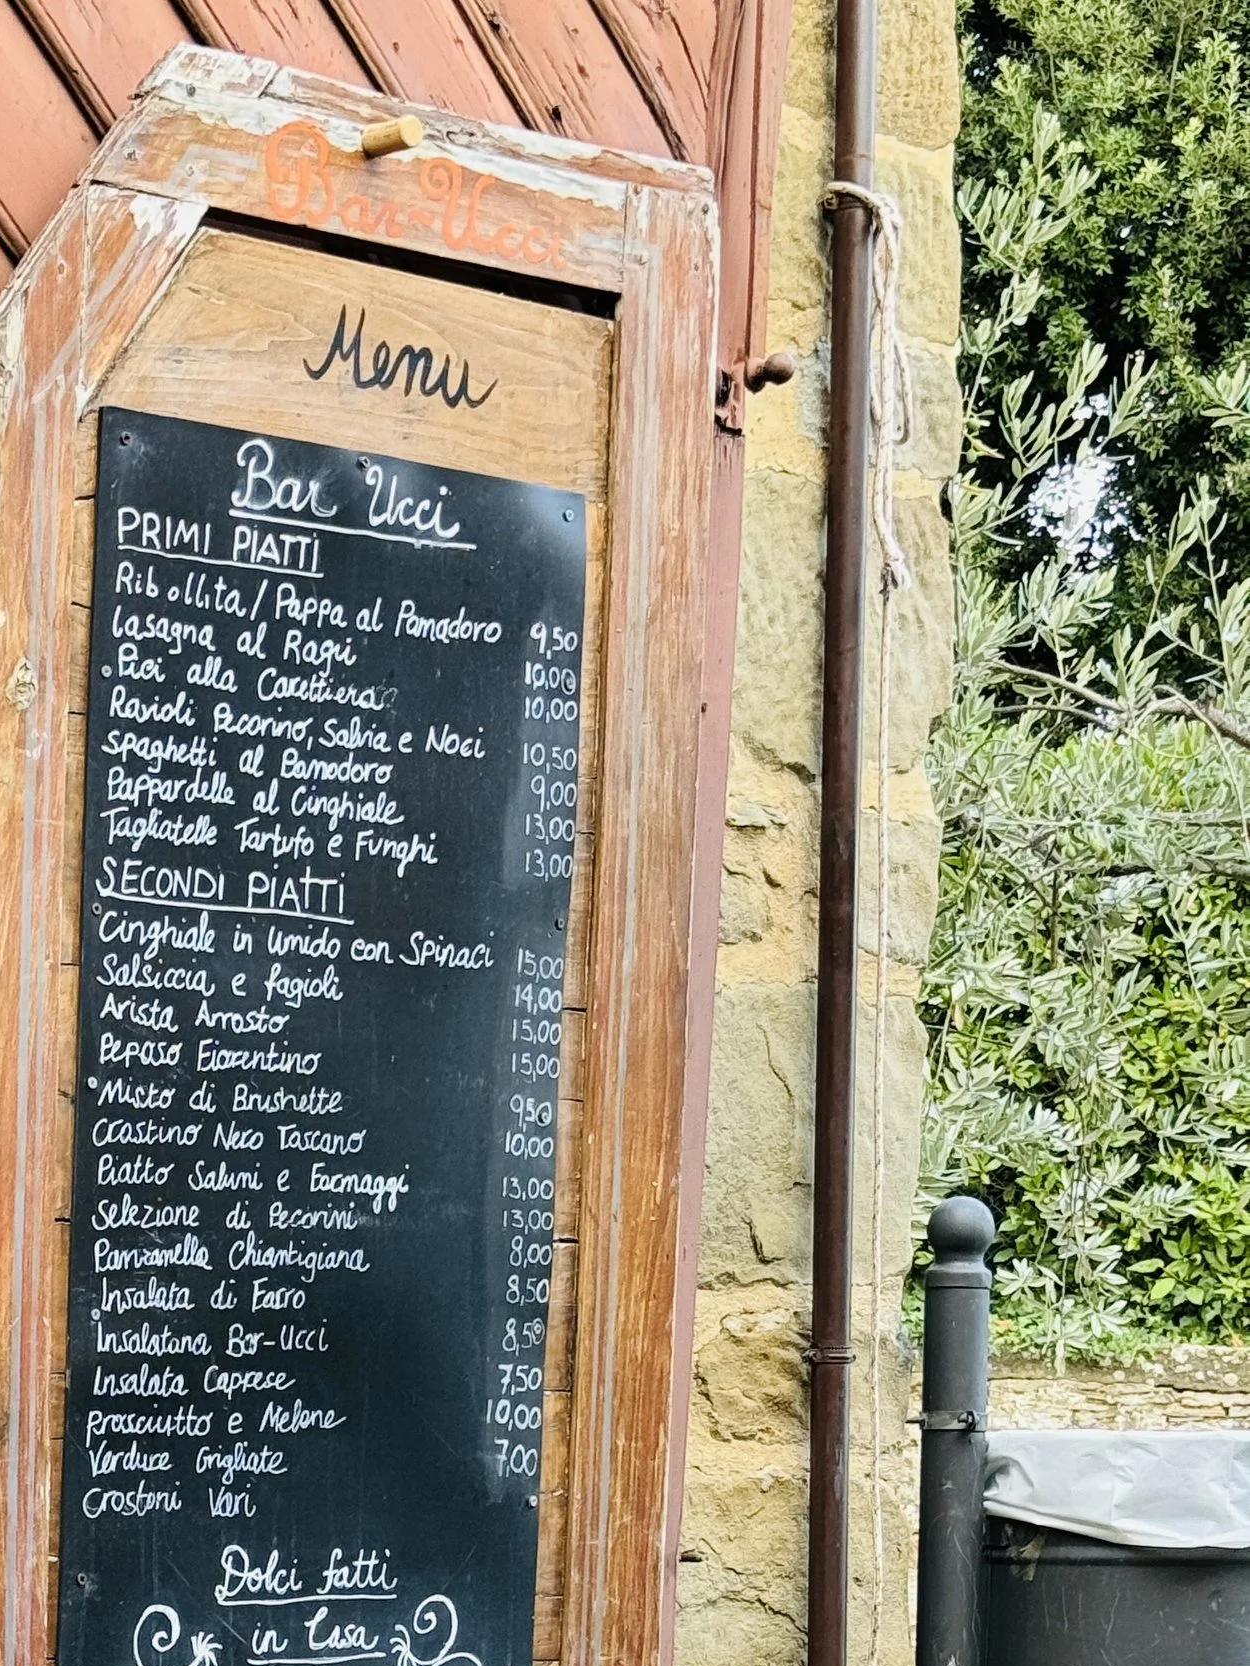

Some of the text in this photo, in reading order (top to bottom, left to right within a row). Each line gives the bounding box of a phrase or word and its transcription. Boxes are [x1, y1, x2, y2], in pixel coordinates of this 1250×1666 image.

[302, 304, 499, 410] Menu
[232, 439, 461, 538] Bar Ucci
[117, 507, 322, 573] PRIMI PIATTI
[115, 561, 246, 617] Ribollita
[275, 583, 347, 627] Pappa
[356, 597, 383, 632] al
[530, 621, 578, 660] 9,50
[118, 642, 165, 683] Pici
[187, 656, 238, 693] alla
[525, 697, 578, 724] 10,00
[237, 622, 266, 659] al
[525, 661, 576, 697] 10,00
[110, 685, 195, 727] Ravioli
[318, 716, 391, 754] Salvia
[398, 734, 413, 753] e
[425, 725, 485, 758] Noci
[523, 742, 577, 775] 10,50
[107, 765, 236, 808] Pappardelle
[252, 778, 280, 816] al
[525, 814, 576, 844] 13,00
[239, 744, 264, 778] al
[530, 775, 577, 813] 9,00
[99, 806, 574, 881] Tagliatelle Tartufo e Funghi 13,00
[95, 857, 347, 915] SECONDI PIATTI
[99, 910, 215, 960] Cinghiale
[233, 923, 253, 954] in
[351, 937, 394, 964] con
[400, 930, 494, 970] Spinaci
[517, 947, 564, 983] 15,00
[100, 993, 563, 1045] Arista Arrosto 15,00
[231, 973, 247, 996] e
[514, 984, 563, 1015] 14,00
[511, 1053, 560, 1084] 15,00
[98, 1078, 176, 1109] Misto
[189, 1080, 216, 1113] di
[509, 1094, 552, 1132] 9,50
[505, 1131, 554, 1161] 10,00
[97, 1154, 175, 1186] Piatto
[188, 1160, 263, 1192] Salumi
[276, 1168, 290, 1192] e
[502, 1176, 554, 1200] 13,00
[91, 1193, 200, 1231] Selezione
[225, 1200, 251, 1230] di
[502, 1210, 554, 1235] 13,00
[509, 1236, 553, 1268] 8,00
[100, 1276, 195, 1315] Insalata
[210, 1279, 238, 1310] di
[506, 1276, 550, 1305] 8,50
[502, 1317, 546, 1355] 8,50
[93, 1363, 543, 1400] Insalata Caprese 7,50
[227, 1411, 244, 1435] e
[486, 1399, 543, 1431] 10,00
[494, 1438, 539, 1478] 7,00
[215, 1544, 398, 1598] Dolci fatti
[252, 1605, 380, 1656] in Casa
